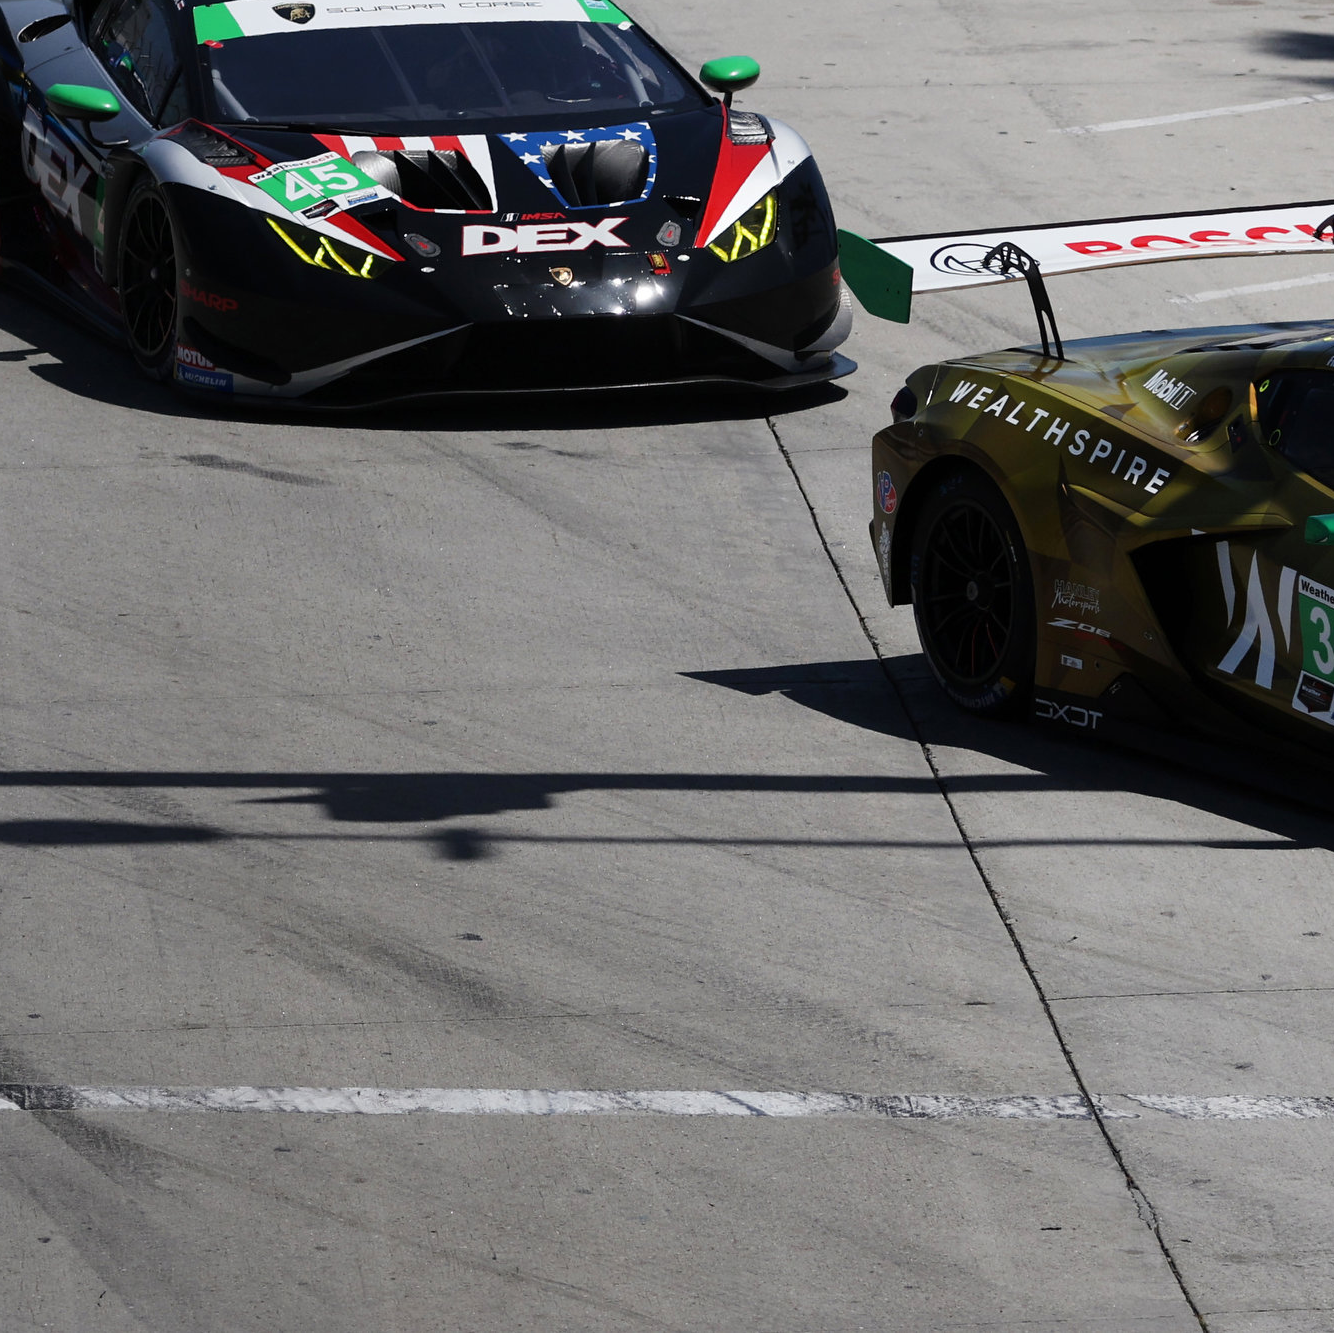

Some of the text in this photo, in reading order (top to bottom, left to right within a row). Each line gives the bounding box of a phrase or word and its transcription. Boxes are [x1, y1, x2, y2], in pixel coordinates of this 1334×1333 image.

[327, 0, 544, 14] SQUADRA CORSE
[21, 113, 92, 237] DEX
[285, 163, 359, 202] 45
[521, 212, 566, 221] IMSA
[462, 217, 630, 256] DEX
[179, 280, 238, 312] SHARP
[184, 372, 226, 387] MICHELIN
[1143, 369, 1181, 404] Mobil
[949, 380, 1170, 495] WEALTHSPIRE
[1035, 698, 1103, 730] DXDT
